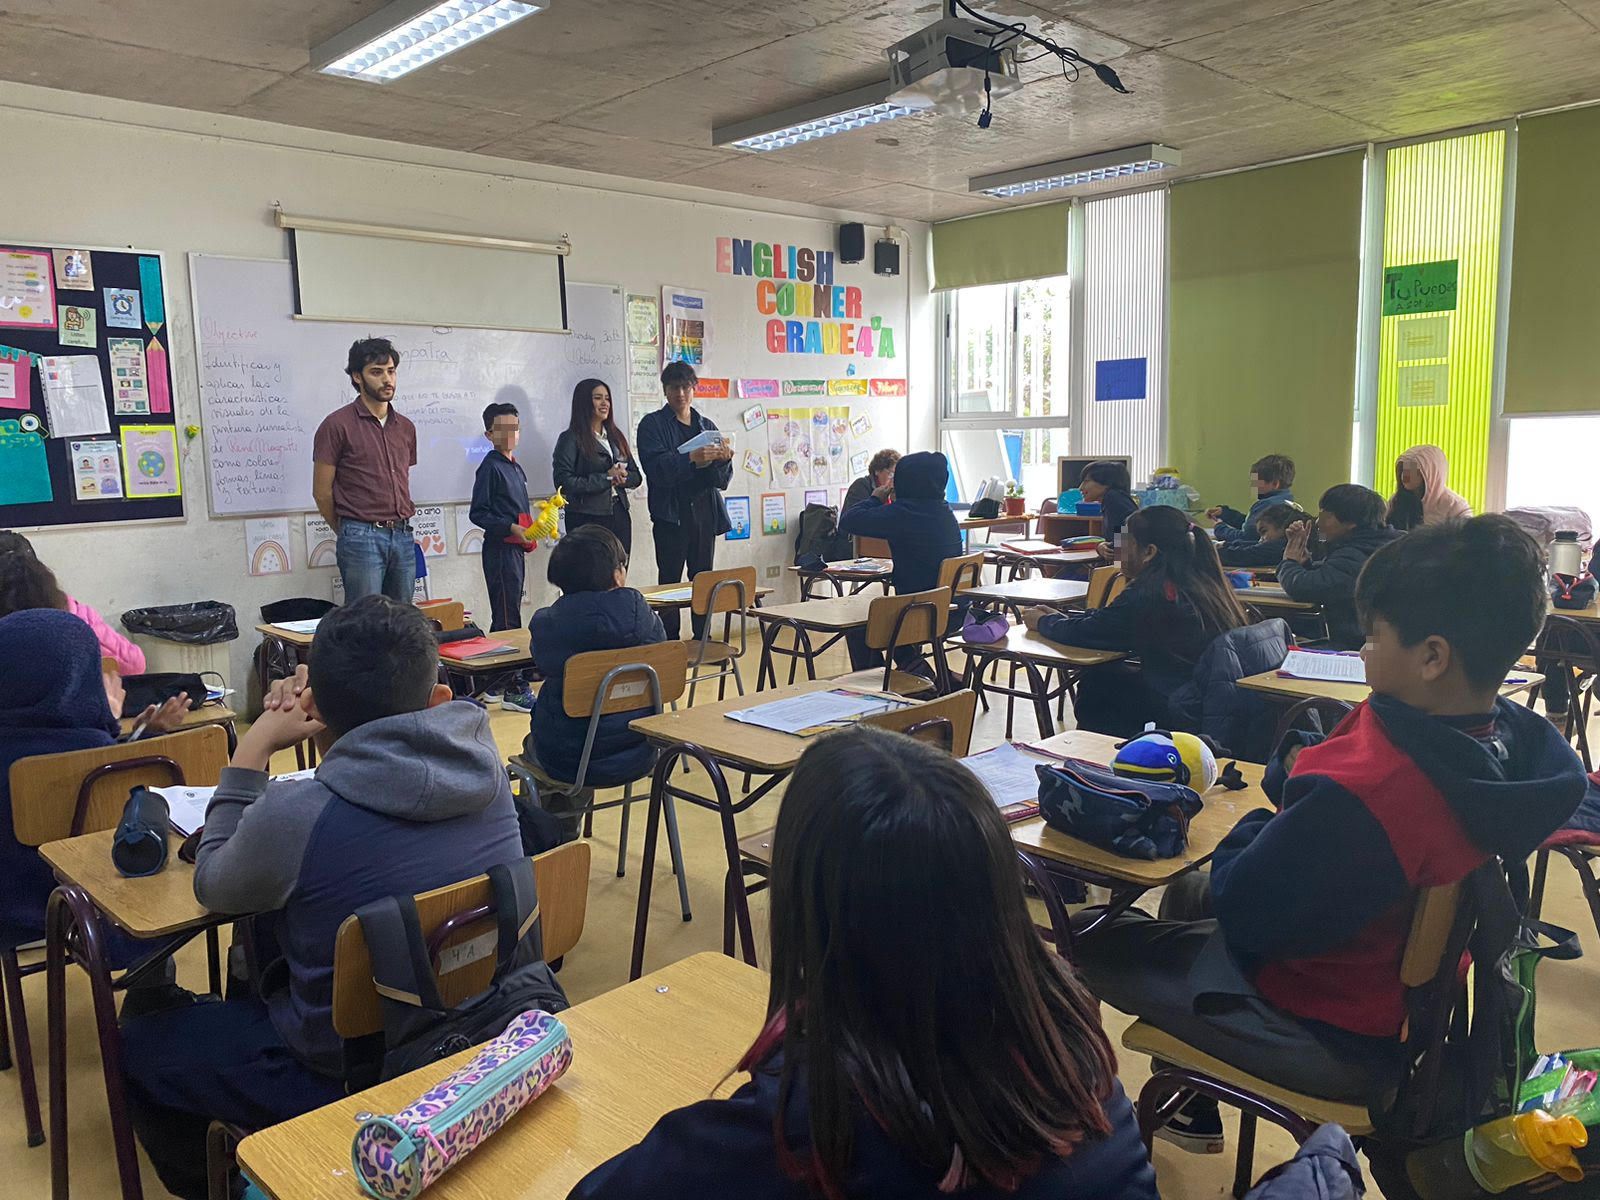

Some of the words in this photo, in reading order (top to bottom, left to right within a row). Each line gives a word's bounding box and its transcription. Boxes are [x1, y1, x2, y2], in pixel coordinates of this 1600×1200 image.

[716, 237, 834, 285] ENGLISH
[757, 279, 862, 319] CORNER
[766, 319, 854, 354] GRADE
[418, 521, 436, 529] cosas
[424, 507, 441, 515] amo
